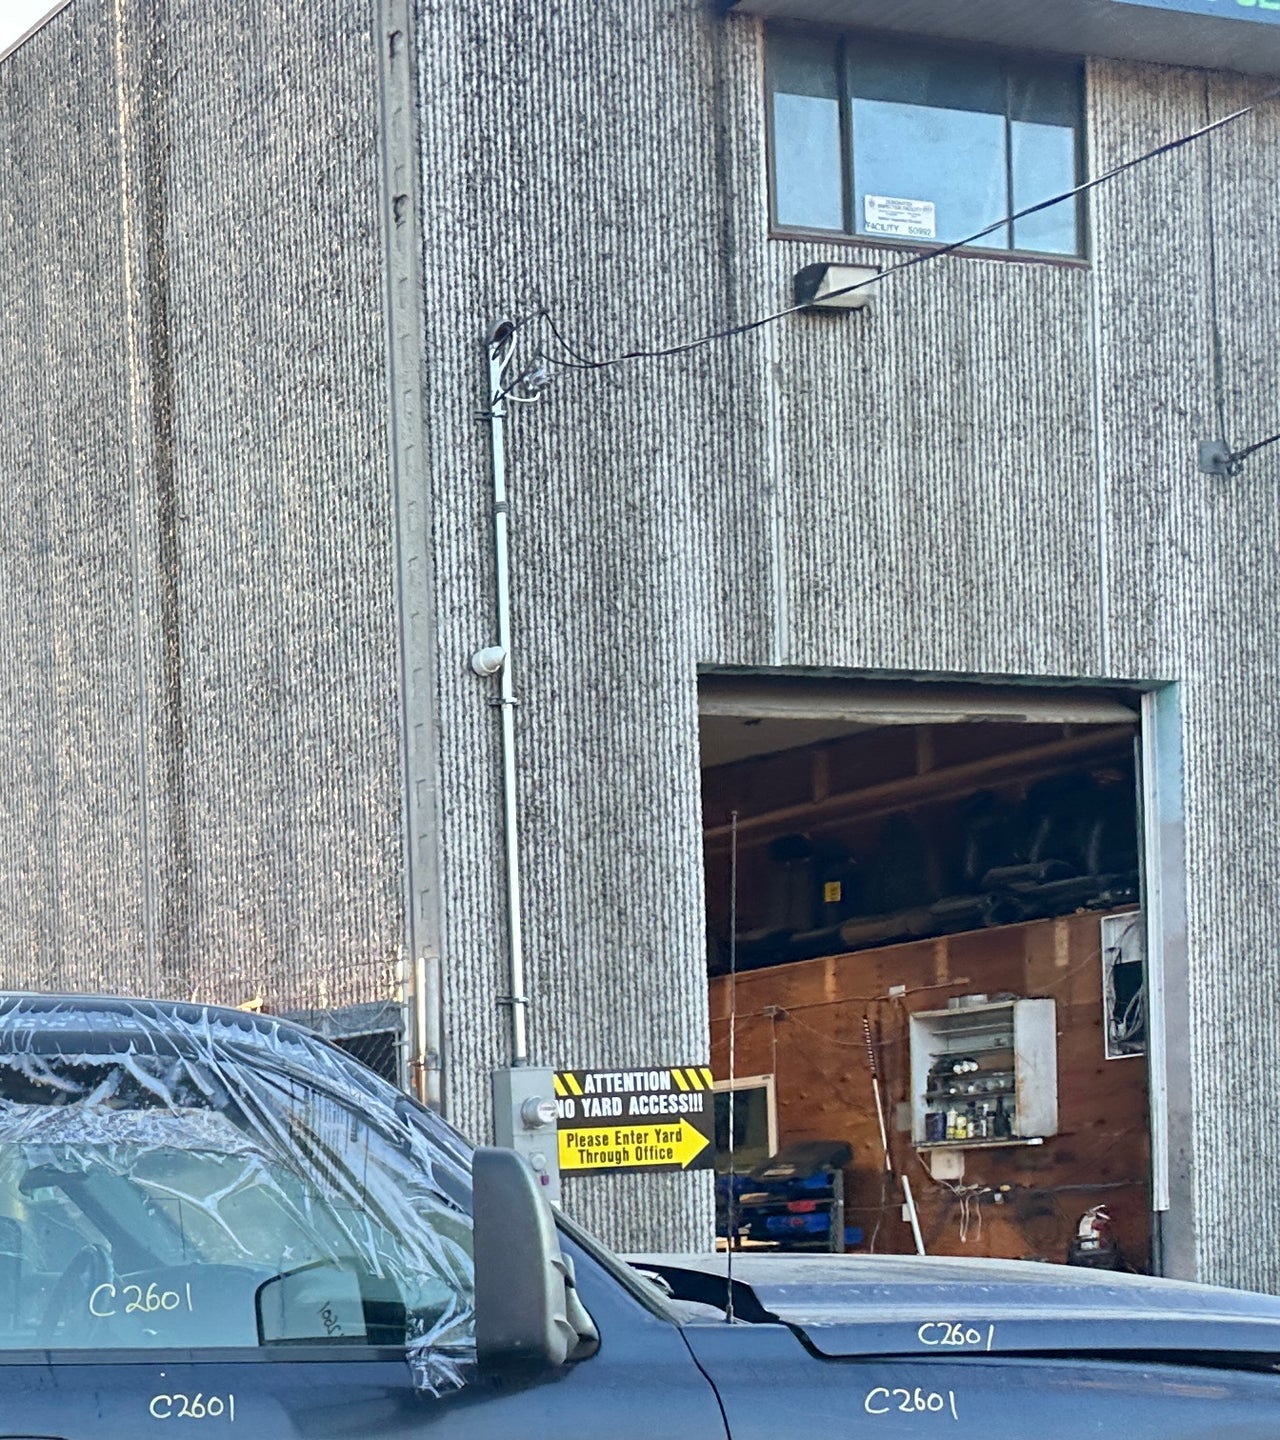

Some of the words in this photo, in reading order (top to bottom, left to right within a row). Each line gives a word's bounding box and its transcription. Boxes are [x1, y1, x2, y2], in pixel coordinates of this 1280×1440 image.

[584, 1071, 671, 1094] ATTENTION
[555, 1099, 576, 1119] NO
[581, 1097, 623, 1117] YARD
[629, 1093, 703, 1115] ACCESS!!!
[566, 1132, 609, 1149] Please
[615, 1130, 648, 1145] Enter
[655, 1128, 682, 1143] Yard
[578, 1147, 630, 1165] Through
[635, 1145, 674, 1162] Office
[89, 1282, 193, 1318] C2601
[918, 1322, 995, 1351] C2601
[149, 1393, 236, 1421] C2601
[864, 1387, 959, 1421] C2601
